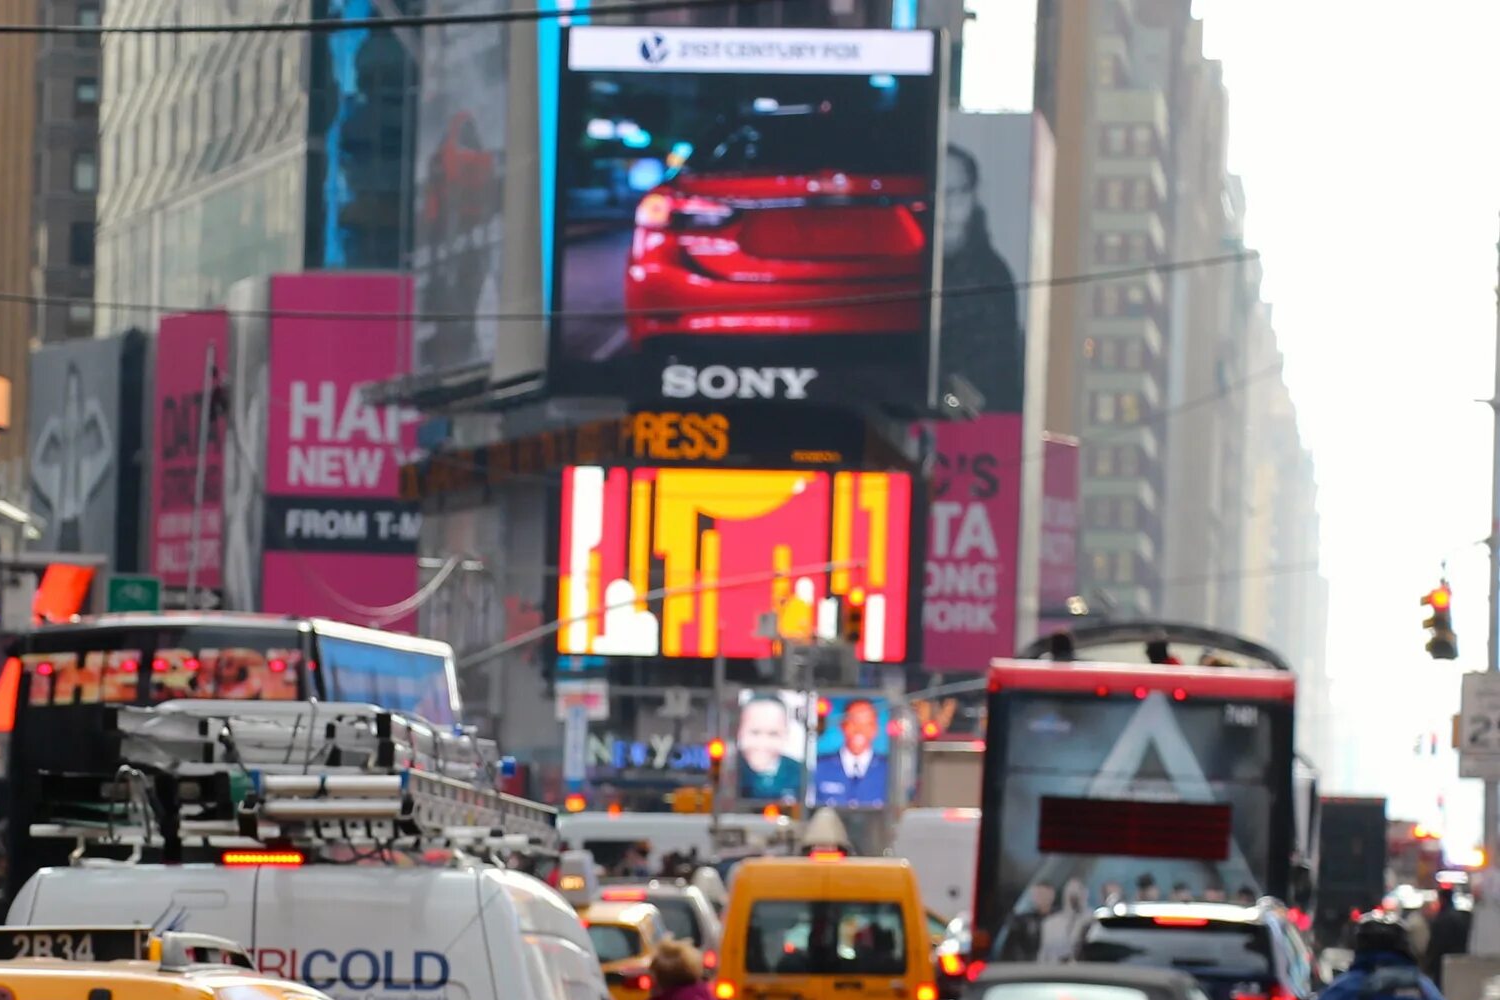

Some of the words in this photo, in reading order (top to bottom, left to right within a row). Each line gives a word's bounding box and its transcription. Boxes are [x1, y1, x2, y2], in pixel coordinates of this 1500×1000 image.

[722, 41, 819, 59] CENTURY
[823, 44, 861, 60] FOX
[661, 364, 819, 400] SONY
[288, 447, 385, 489] NEW
[285, 508, 367, 540] FROM
[21, 650, 141, 706] THE
[151, 646, 302, 700] RIDE
[1468, 714, 1500, 747] 2
[240, 947, 451, 992] RICOLD
